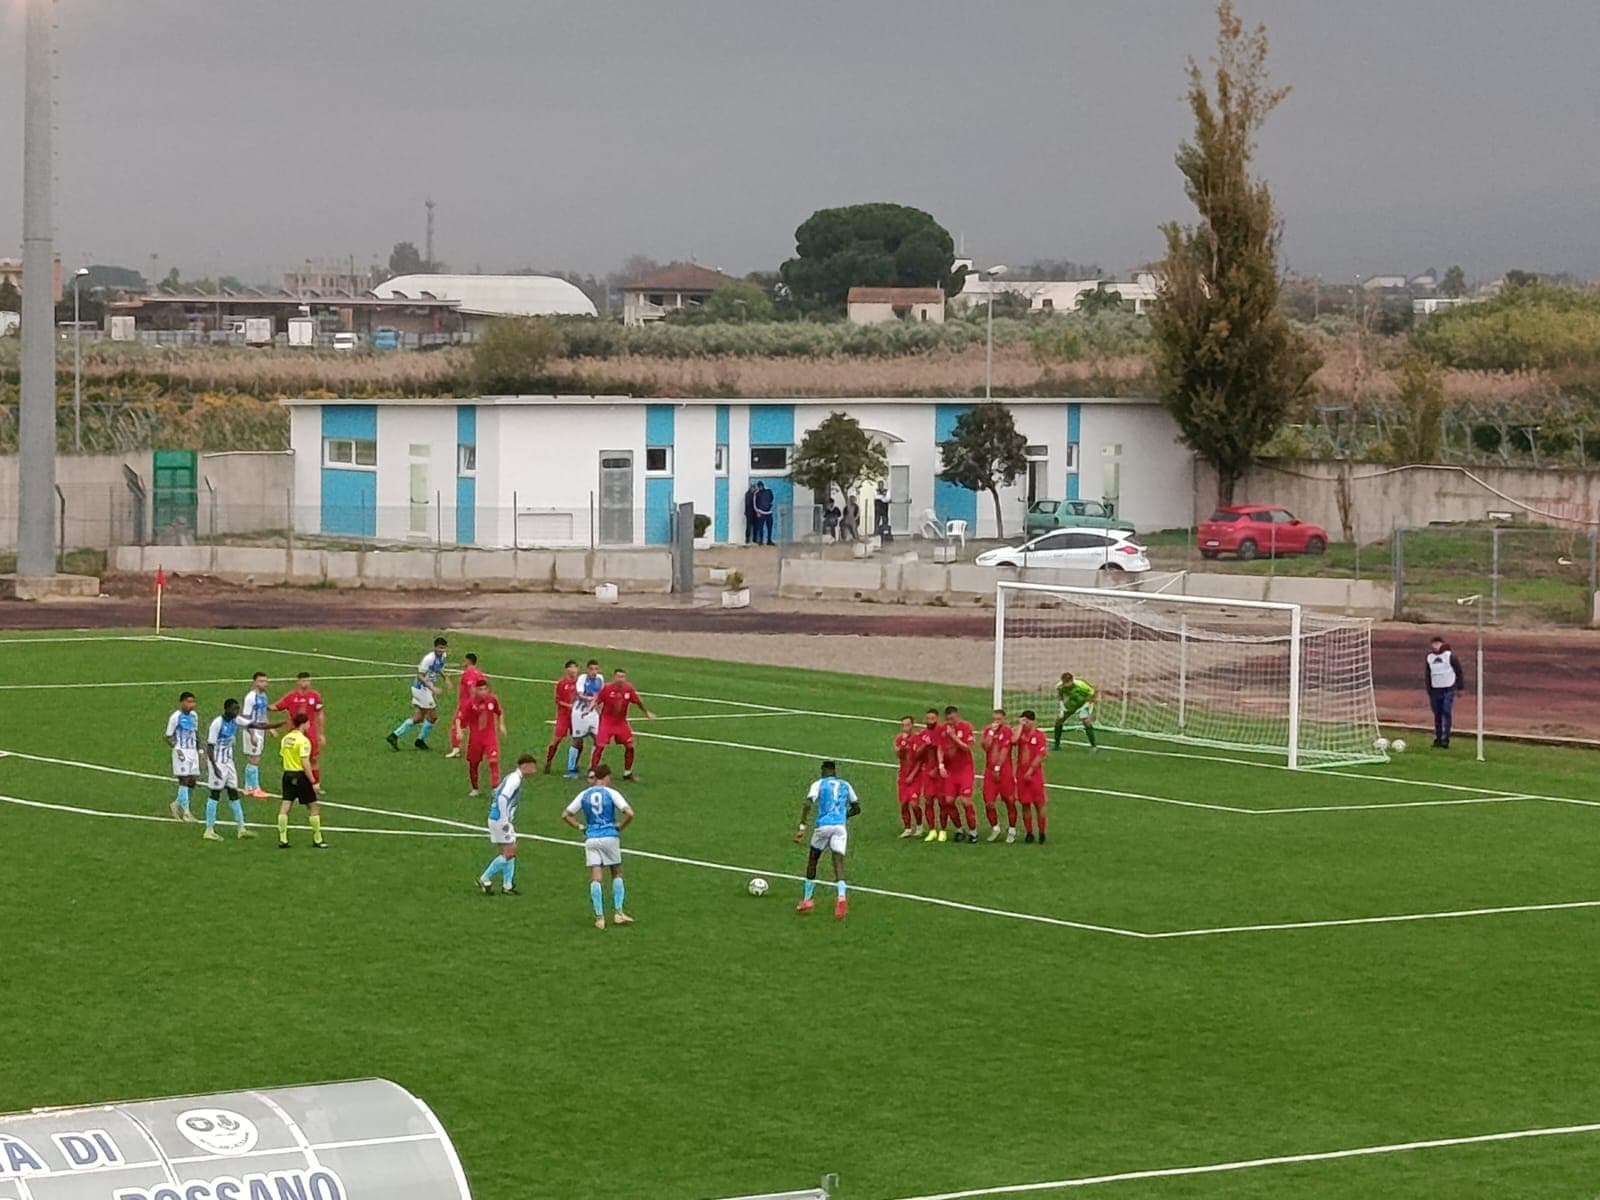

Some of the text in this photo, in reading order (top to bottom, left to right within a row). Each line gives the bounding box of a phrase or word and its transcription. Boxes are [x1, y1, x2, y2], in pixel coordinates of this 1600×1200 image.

[828, 779, 840, 801] 7
[590, 791, 603, 815] 9
[58, 1133, 118, 1165] DI
